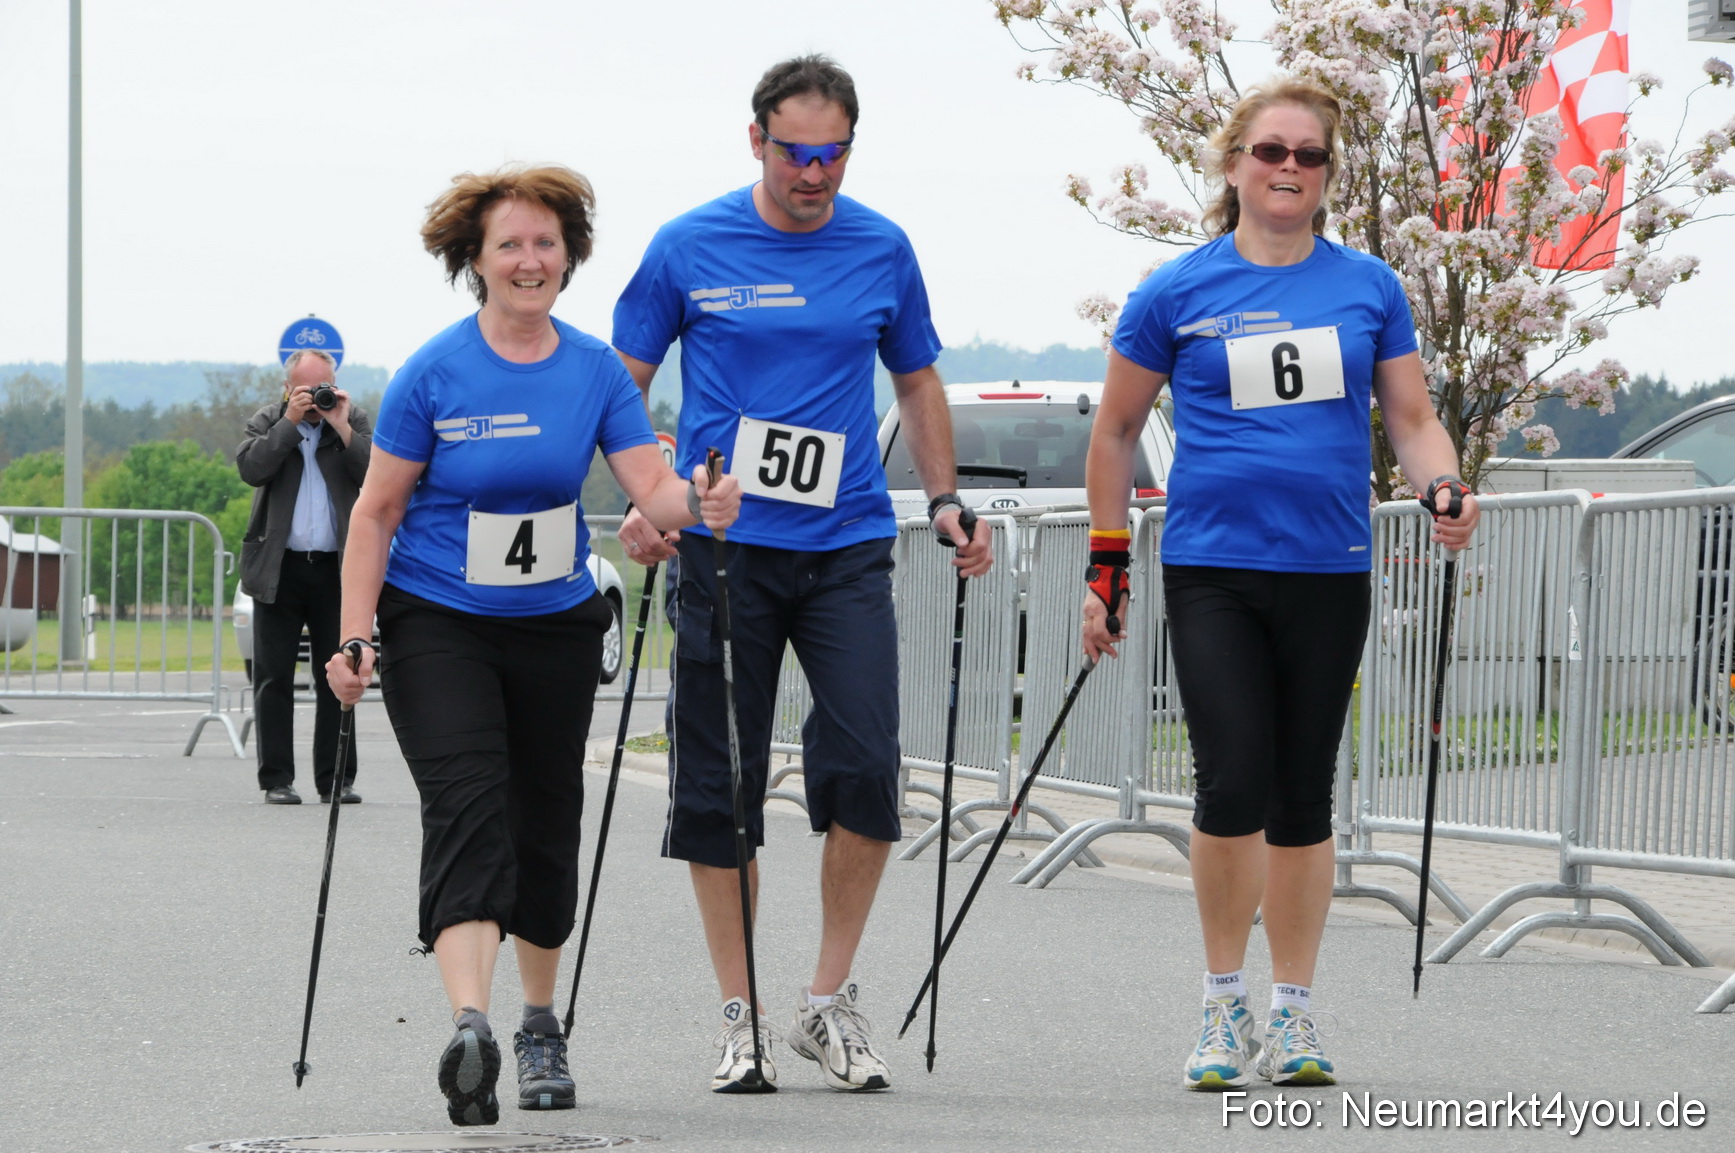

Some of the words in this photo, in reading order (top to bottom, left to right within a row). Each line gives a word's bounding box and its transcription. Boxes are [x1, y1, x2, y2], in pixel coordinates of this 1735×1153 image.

[1271, 342, 1304, 401] 6
[758, 428, 826, 494] 50
[994, 500, 1016, 510] KIA
[504, 519, 538, 575] 4
[1215, 975, 1239, 986] SOCKS
[1277, 986, 1296, 996] TECH
